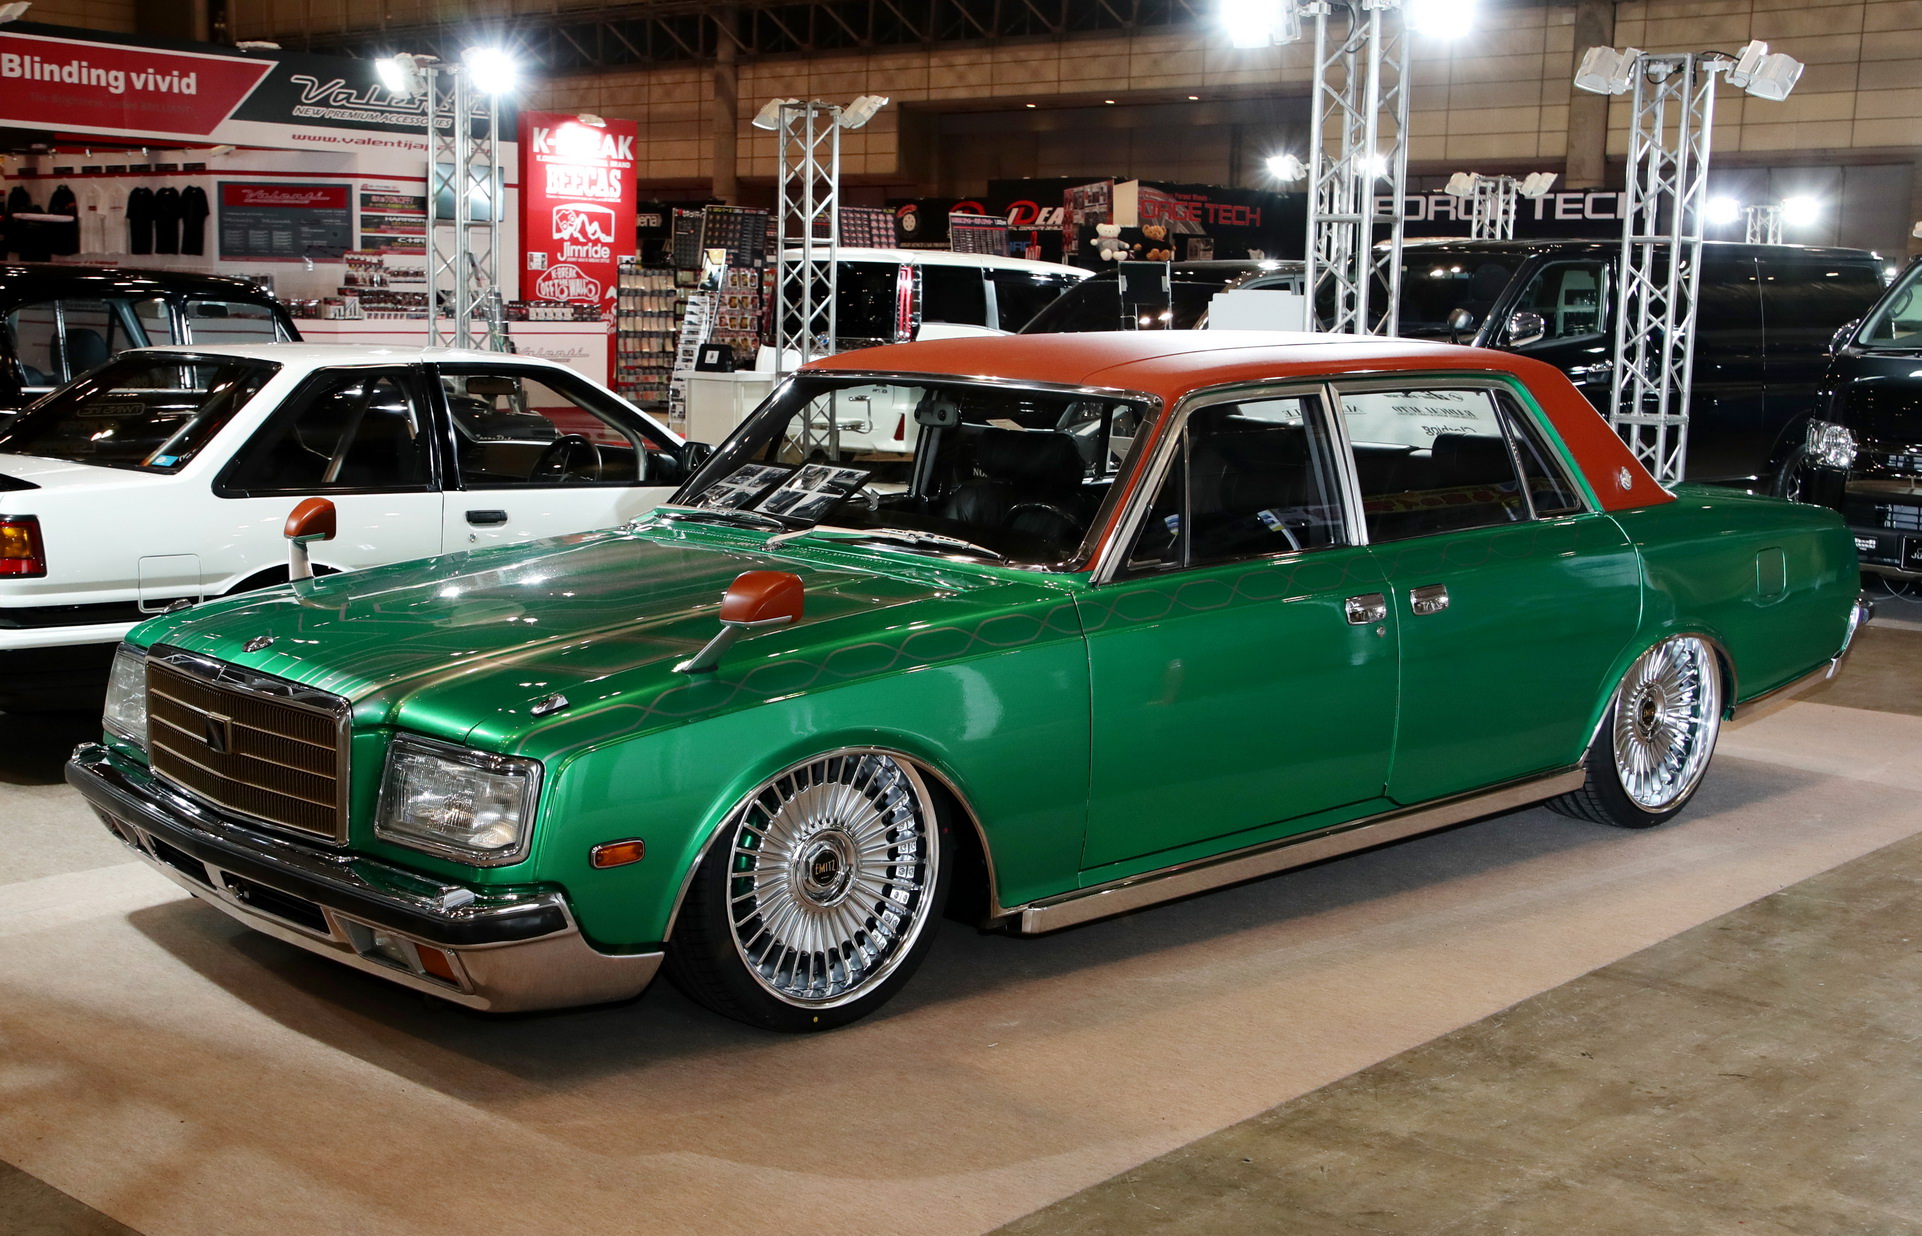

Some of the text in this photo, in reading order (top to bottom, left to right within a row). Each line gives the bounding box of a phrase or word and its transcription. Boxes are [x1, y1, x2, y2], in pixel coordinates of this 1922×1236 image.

[1, 52, 197, 95] Blinding vivid
[292, 105, 452, 128] NEW PREMIUM ACCESSOIES
[545, 164, 622, 198] BEECAS
[1138, 199, 1260, 227] ORGE TECH
[557, 242, 611, 261] Jimride
[814, 859, 836, 876] EMITZ
